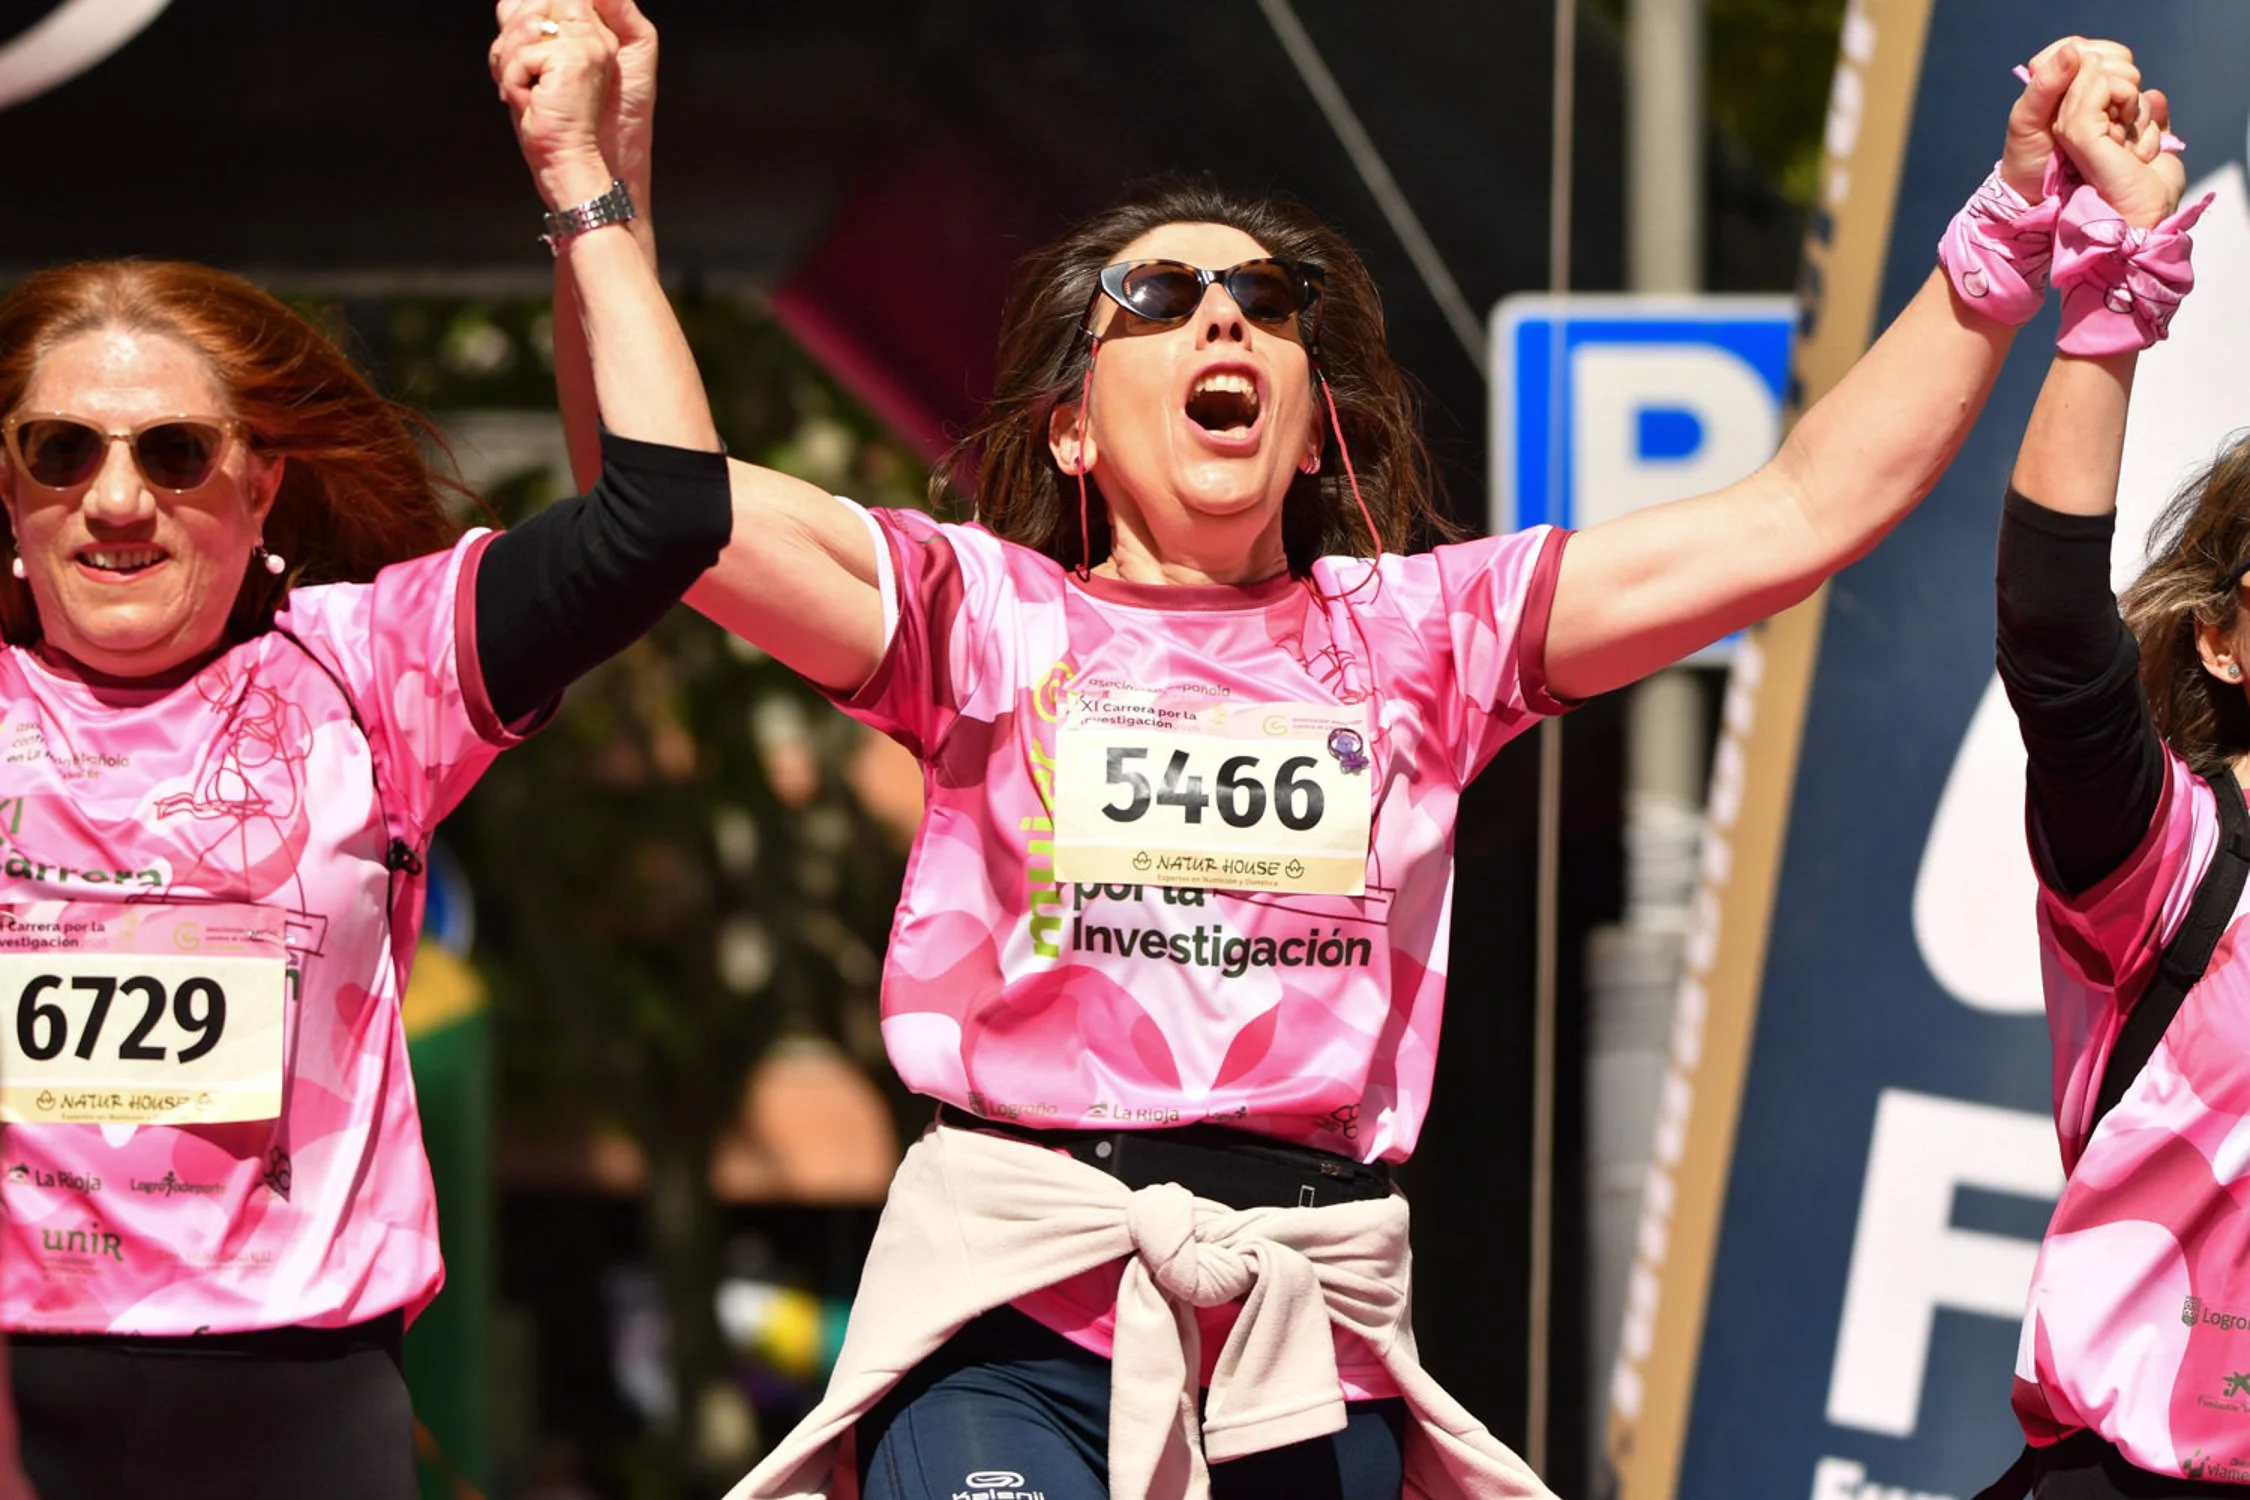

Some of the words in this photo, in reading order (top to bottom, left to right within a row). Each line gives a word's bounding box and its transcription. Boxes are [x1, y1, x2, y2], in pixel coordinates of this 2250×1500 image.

[1573, 343, 1784, 532] P
[1103, 703, 1155, 714] Carrera
[1158, 708, 1181, 721] por
[1184, 710, 1197, 721] la
[1101, 747, 1325, 831] 5466
[1156, 856, 1218, 871] NATUR
[1222, 858, 1281, 876] HOUSE
[9, 921, 60, 933] Carrera
[64, 922, 86, 934] por
[91, 921, 105, 932] la
[1073, 917, 1371, 979] Investigación
[16, 974, 226, 1064] 6729
[60, 1094, 123, 1110] NATUR
[989, 1101, 1058, 1119] Logroño
[1113, 1105, 1132, 1120] La
[1136, 1105, 1180, 1123] Rioja
[35, 1170, 55, 1188] La
[57, 1170, 102, 1194] Rioja
[2202, 1307, 2250, 1331] Logro
